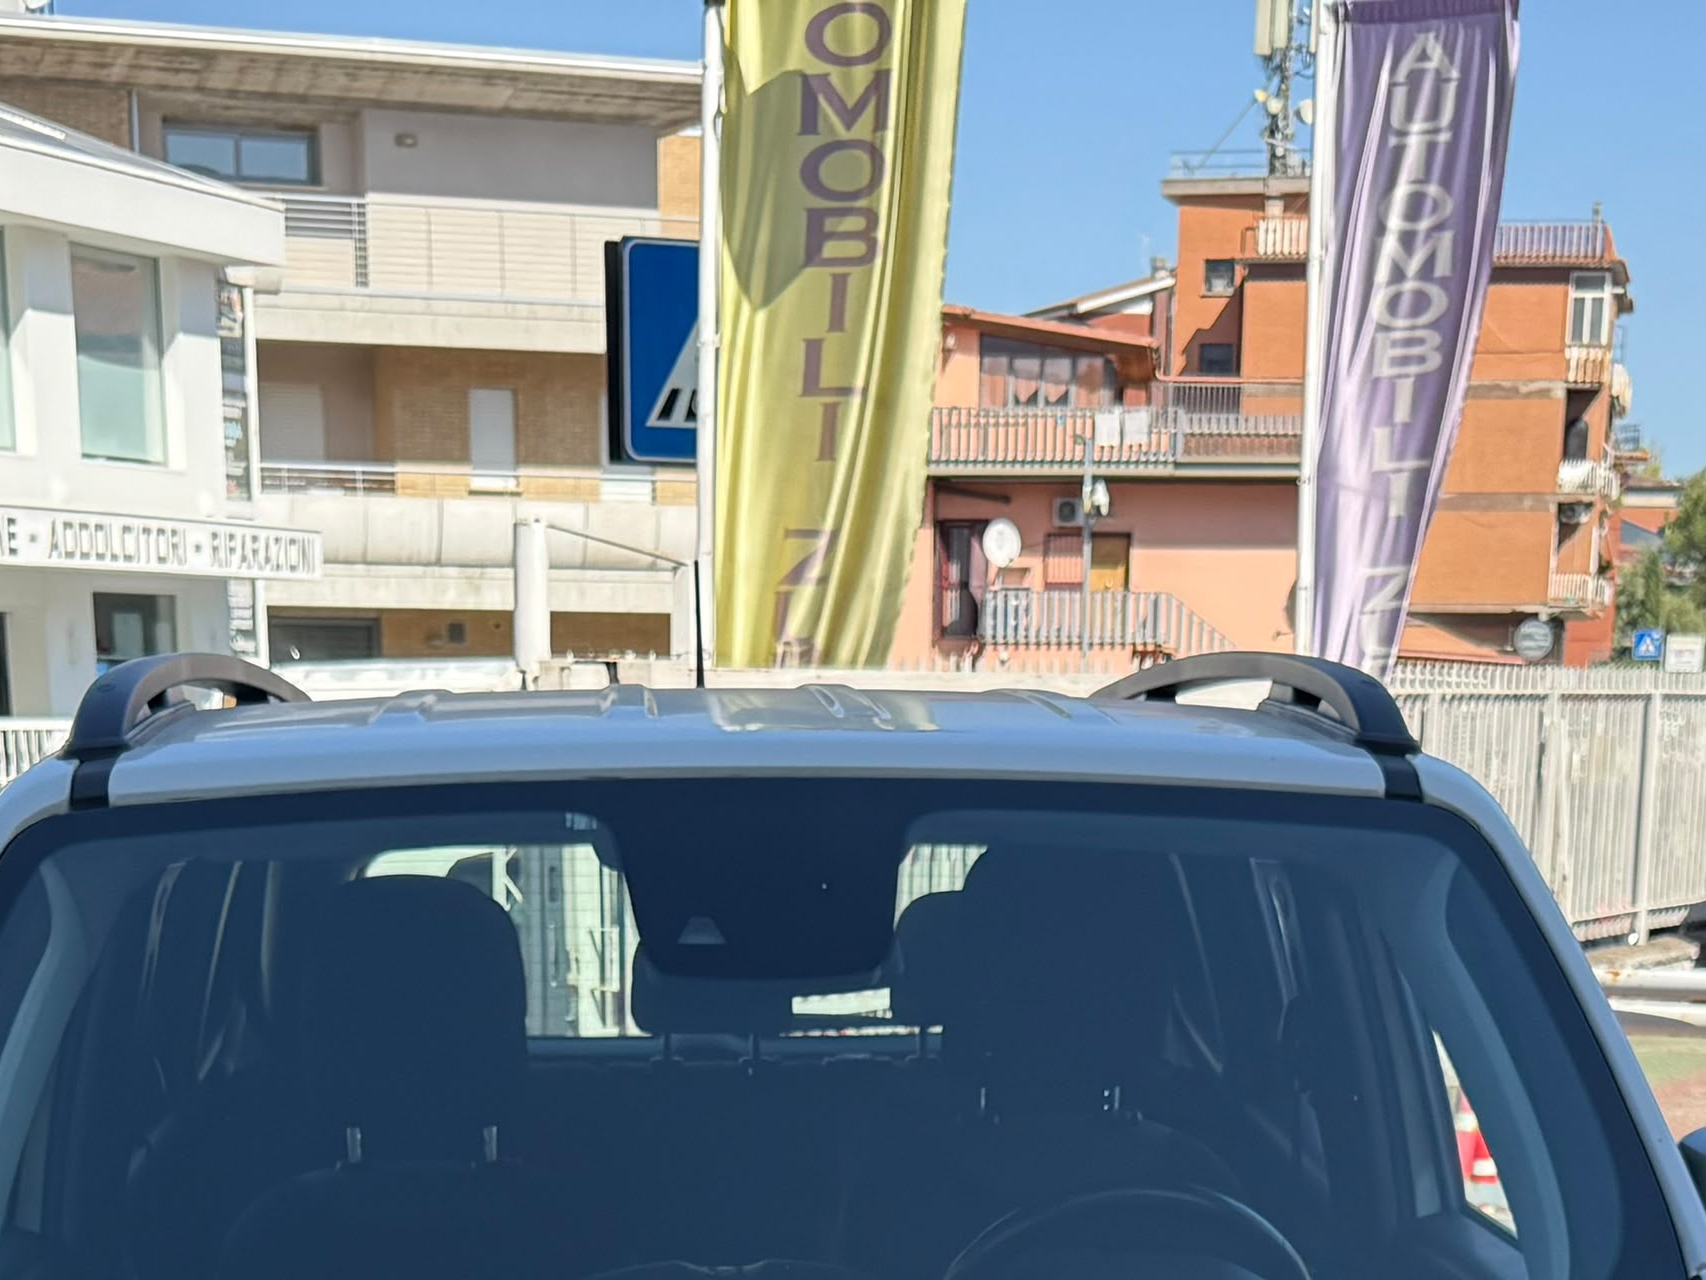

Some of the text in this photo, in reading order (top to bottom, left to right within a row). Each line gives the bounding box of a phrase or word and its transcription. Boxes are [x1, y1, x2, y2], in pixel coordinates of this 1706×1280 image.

[1372, 32, 1458, 517] AUTOMOBILI
[48, 517, 188, 566] ADDOLCITORI
[210, 531, 317, 574] RIPARAZIONI
